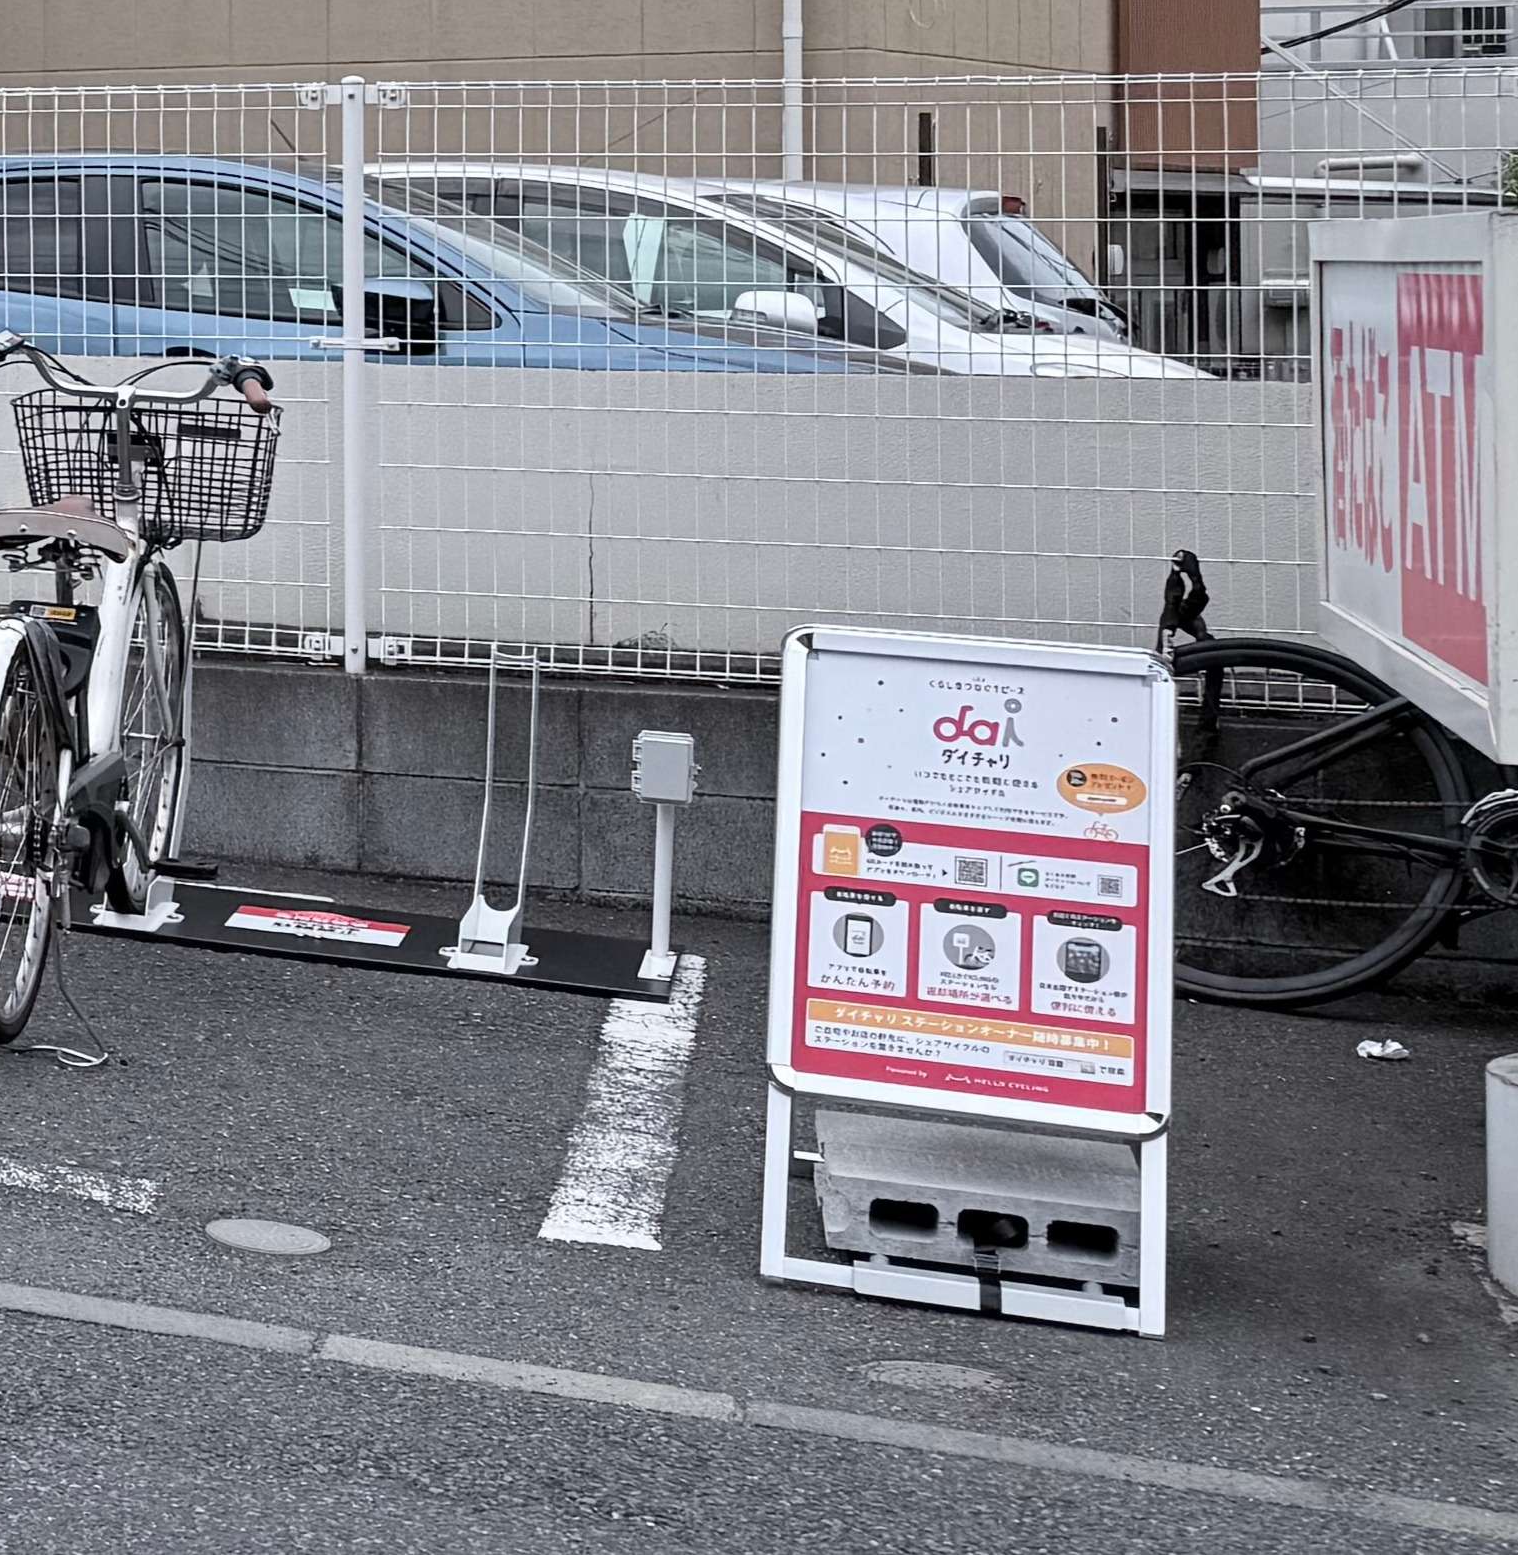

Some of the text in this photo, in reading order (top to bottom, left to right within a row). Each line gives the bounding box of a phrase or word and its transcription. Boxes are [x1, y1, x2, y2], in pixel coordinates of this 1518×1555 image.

[941, 749, 1010, 769] ダイチャリ
[821, 974, 896, 991] かんたん予約
